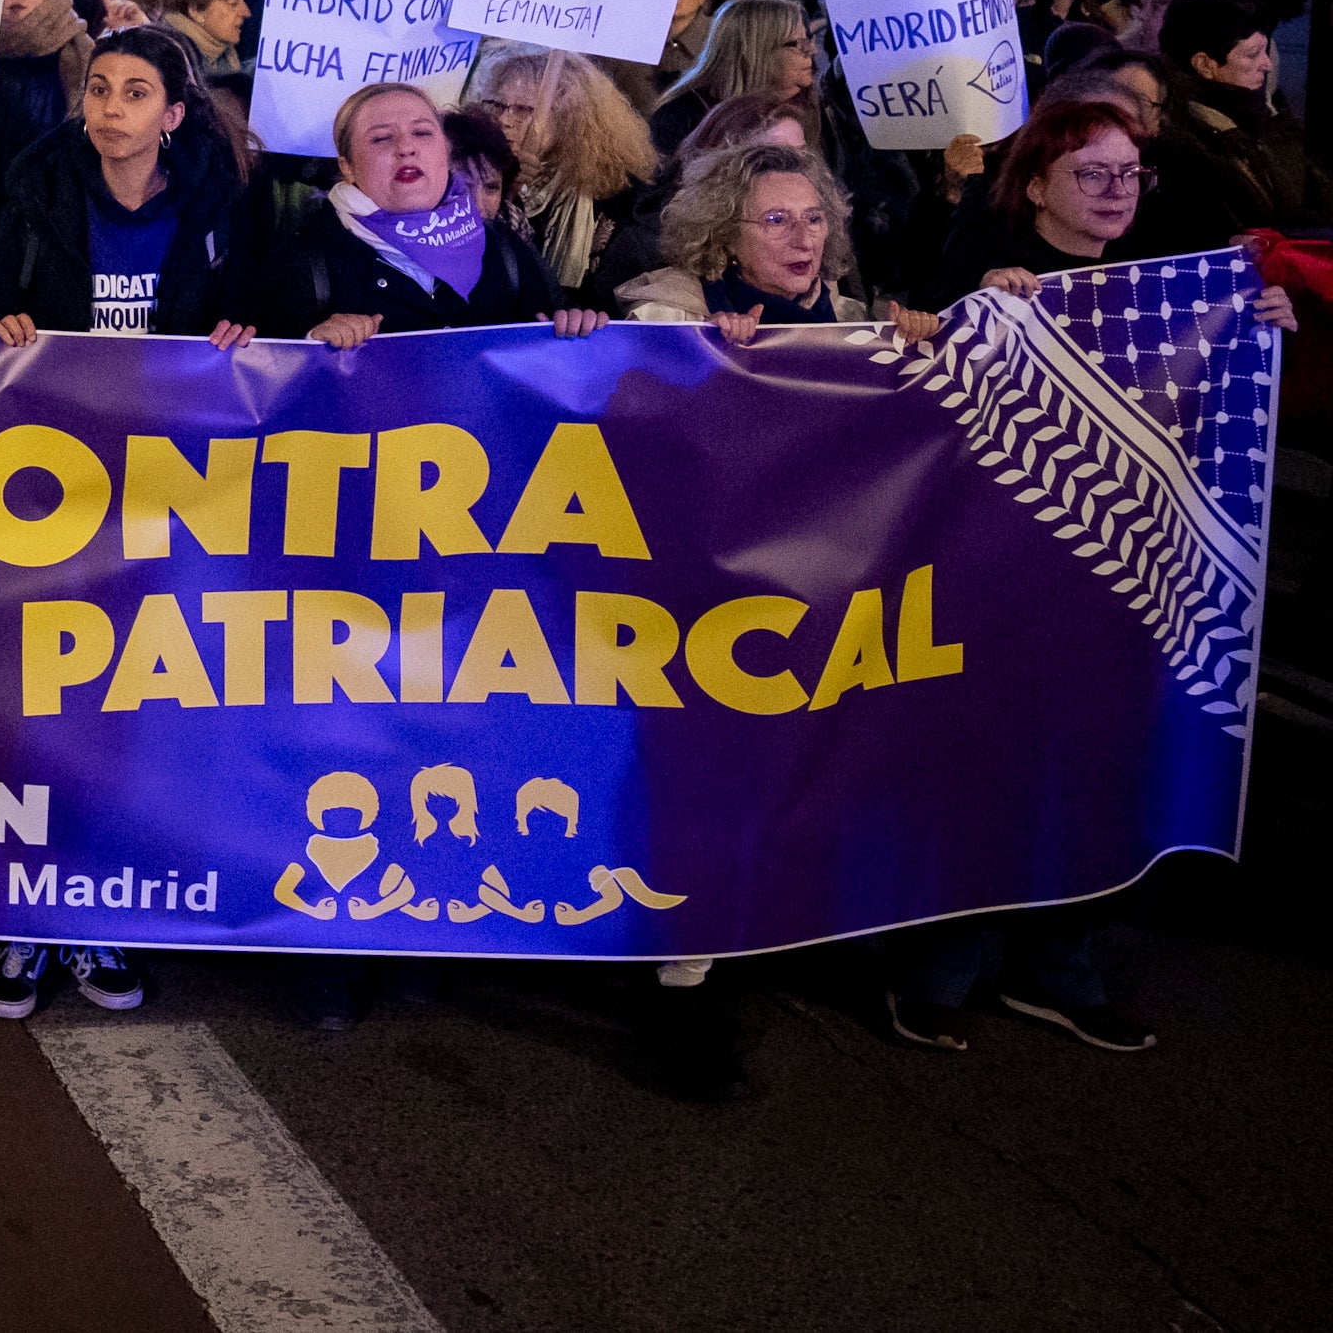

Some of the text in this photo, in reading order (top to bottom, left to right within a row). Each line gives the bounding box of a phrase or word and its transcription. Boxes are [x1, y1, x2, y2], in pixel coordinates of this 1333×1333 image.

[835, 8, 957, 56] MADRID
[257, 37, 474, 82] LUCHA FEMINISTA
[857, 66, 948, 117] SERÁ
[445, 217, 477, 243] Madrid
[92, 272, 160, 298] DICAT
[22, 565, 963, 716] PATRIARCAL
[8, 862, 218, 912] Madrid
